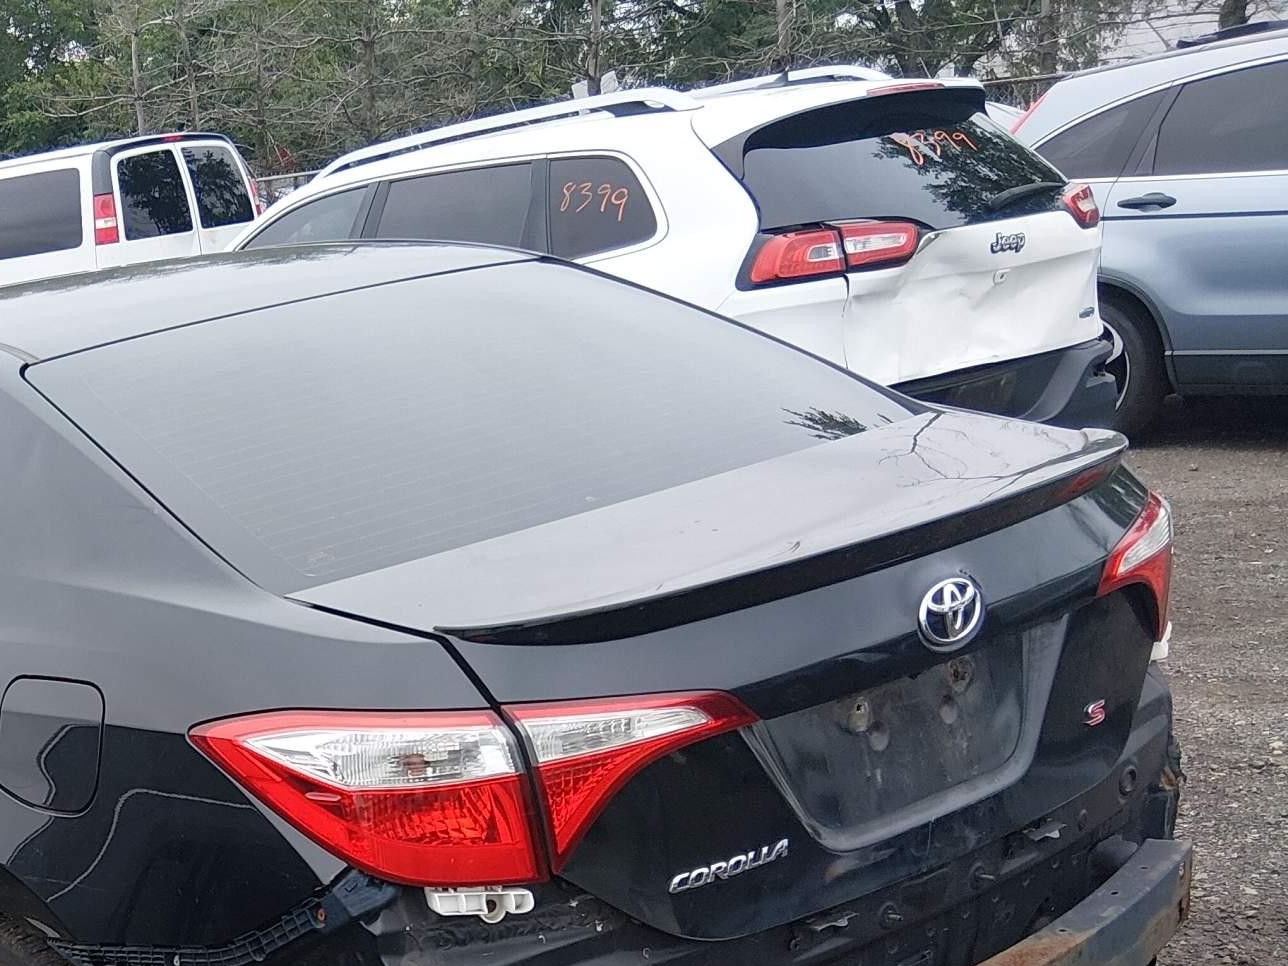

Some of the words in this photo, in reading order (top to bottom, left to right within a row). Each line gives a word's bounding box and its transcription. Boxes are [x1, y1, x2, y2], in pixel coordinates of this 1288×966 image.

[891, 130, 978, 166] 8399
[559, 181, 629, 222] 8399
[990, 231, 1026, 254] Jeep
[1083, 699, 1106, 726] S
[668, 838, 789, 894] COROLLA
